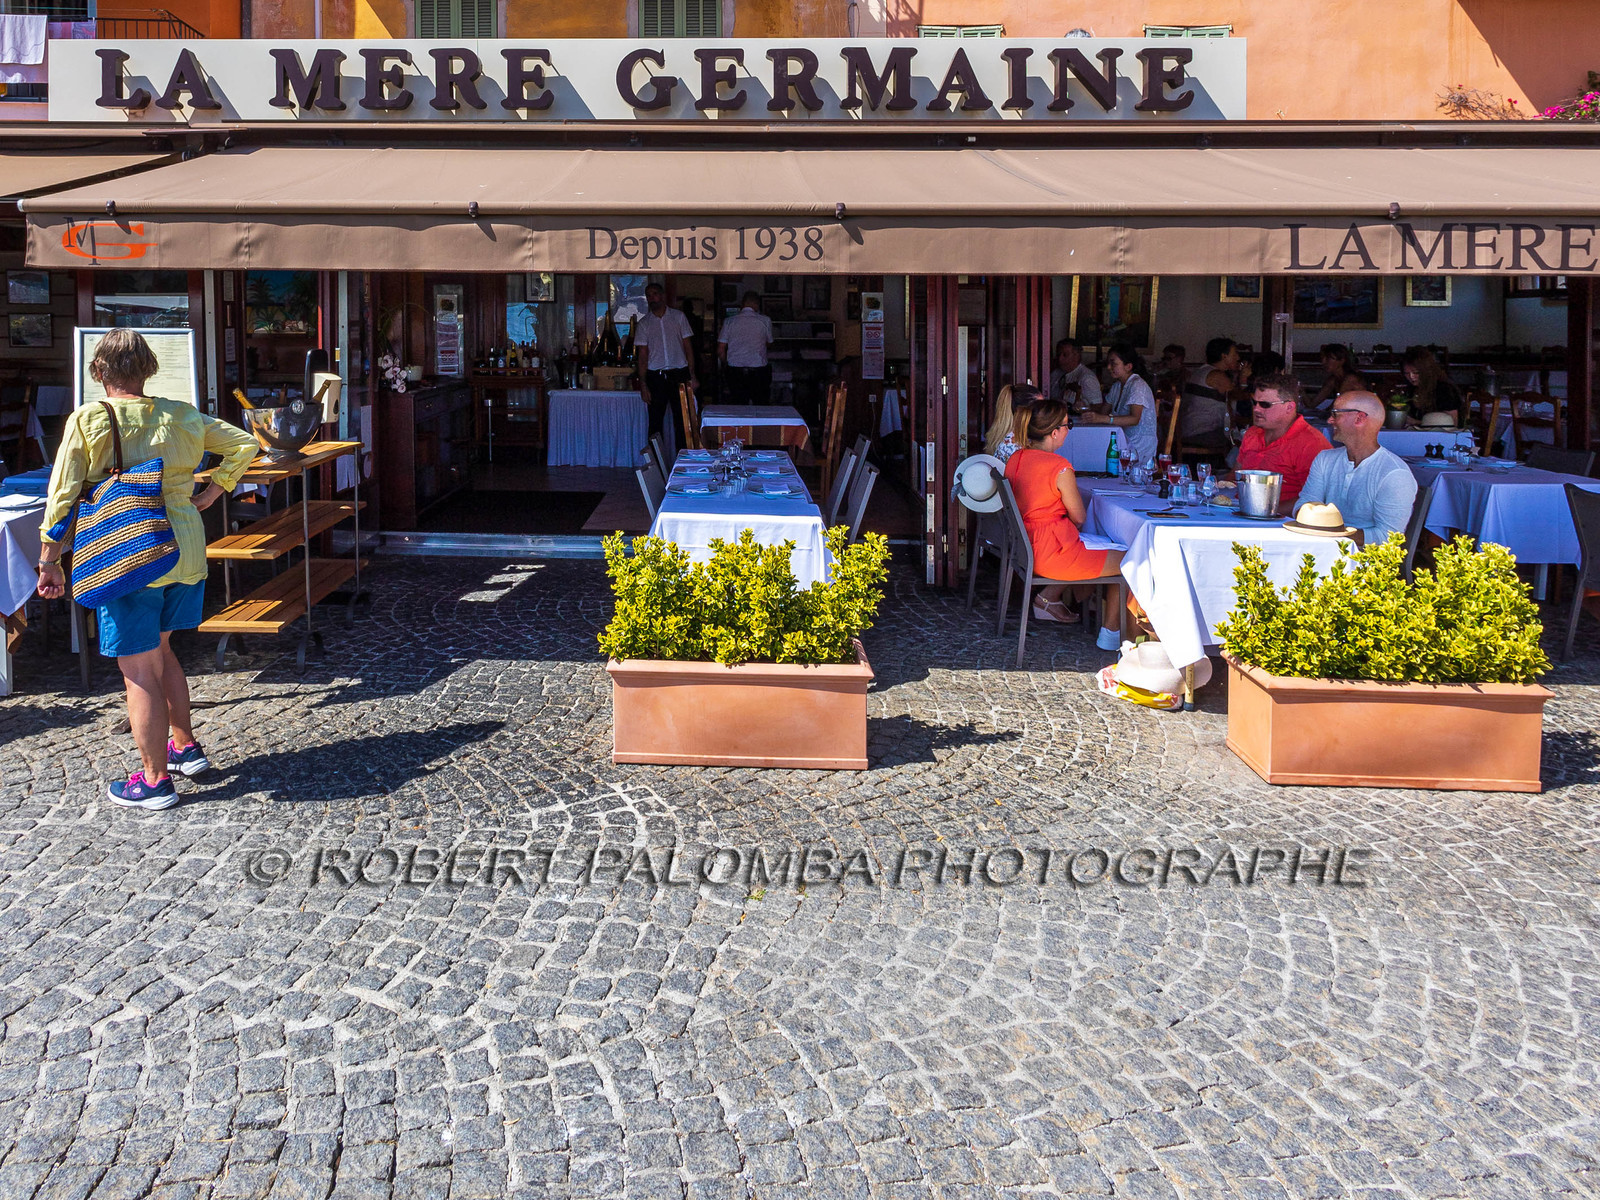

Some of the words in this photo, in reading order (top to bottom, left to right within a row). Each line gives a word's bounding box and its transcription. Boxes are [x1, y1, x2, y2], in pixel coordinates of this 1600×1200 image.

[95, 48, 222, 110] LA
[269, 48, 555, 111] MERE
[616, 47, 1194, 112] GERMAINE
[586, 226, 717, 269] Depuis
[735, 227, 824, 260] 1938
[1284, 223, 1379, 270] LA
[1395, 223, 1598, 271] MERE
